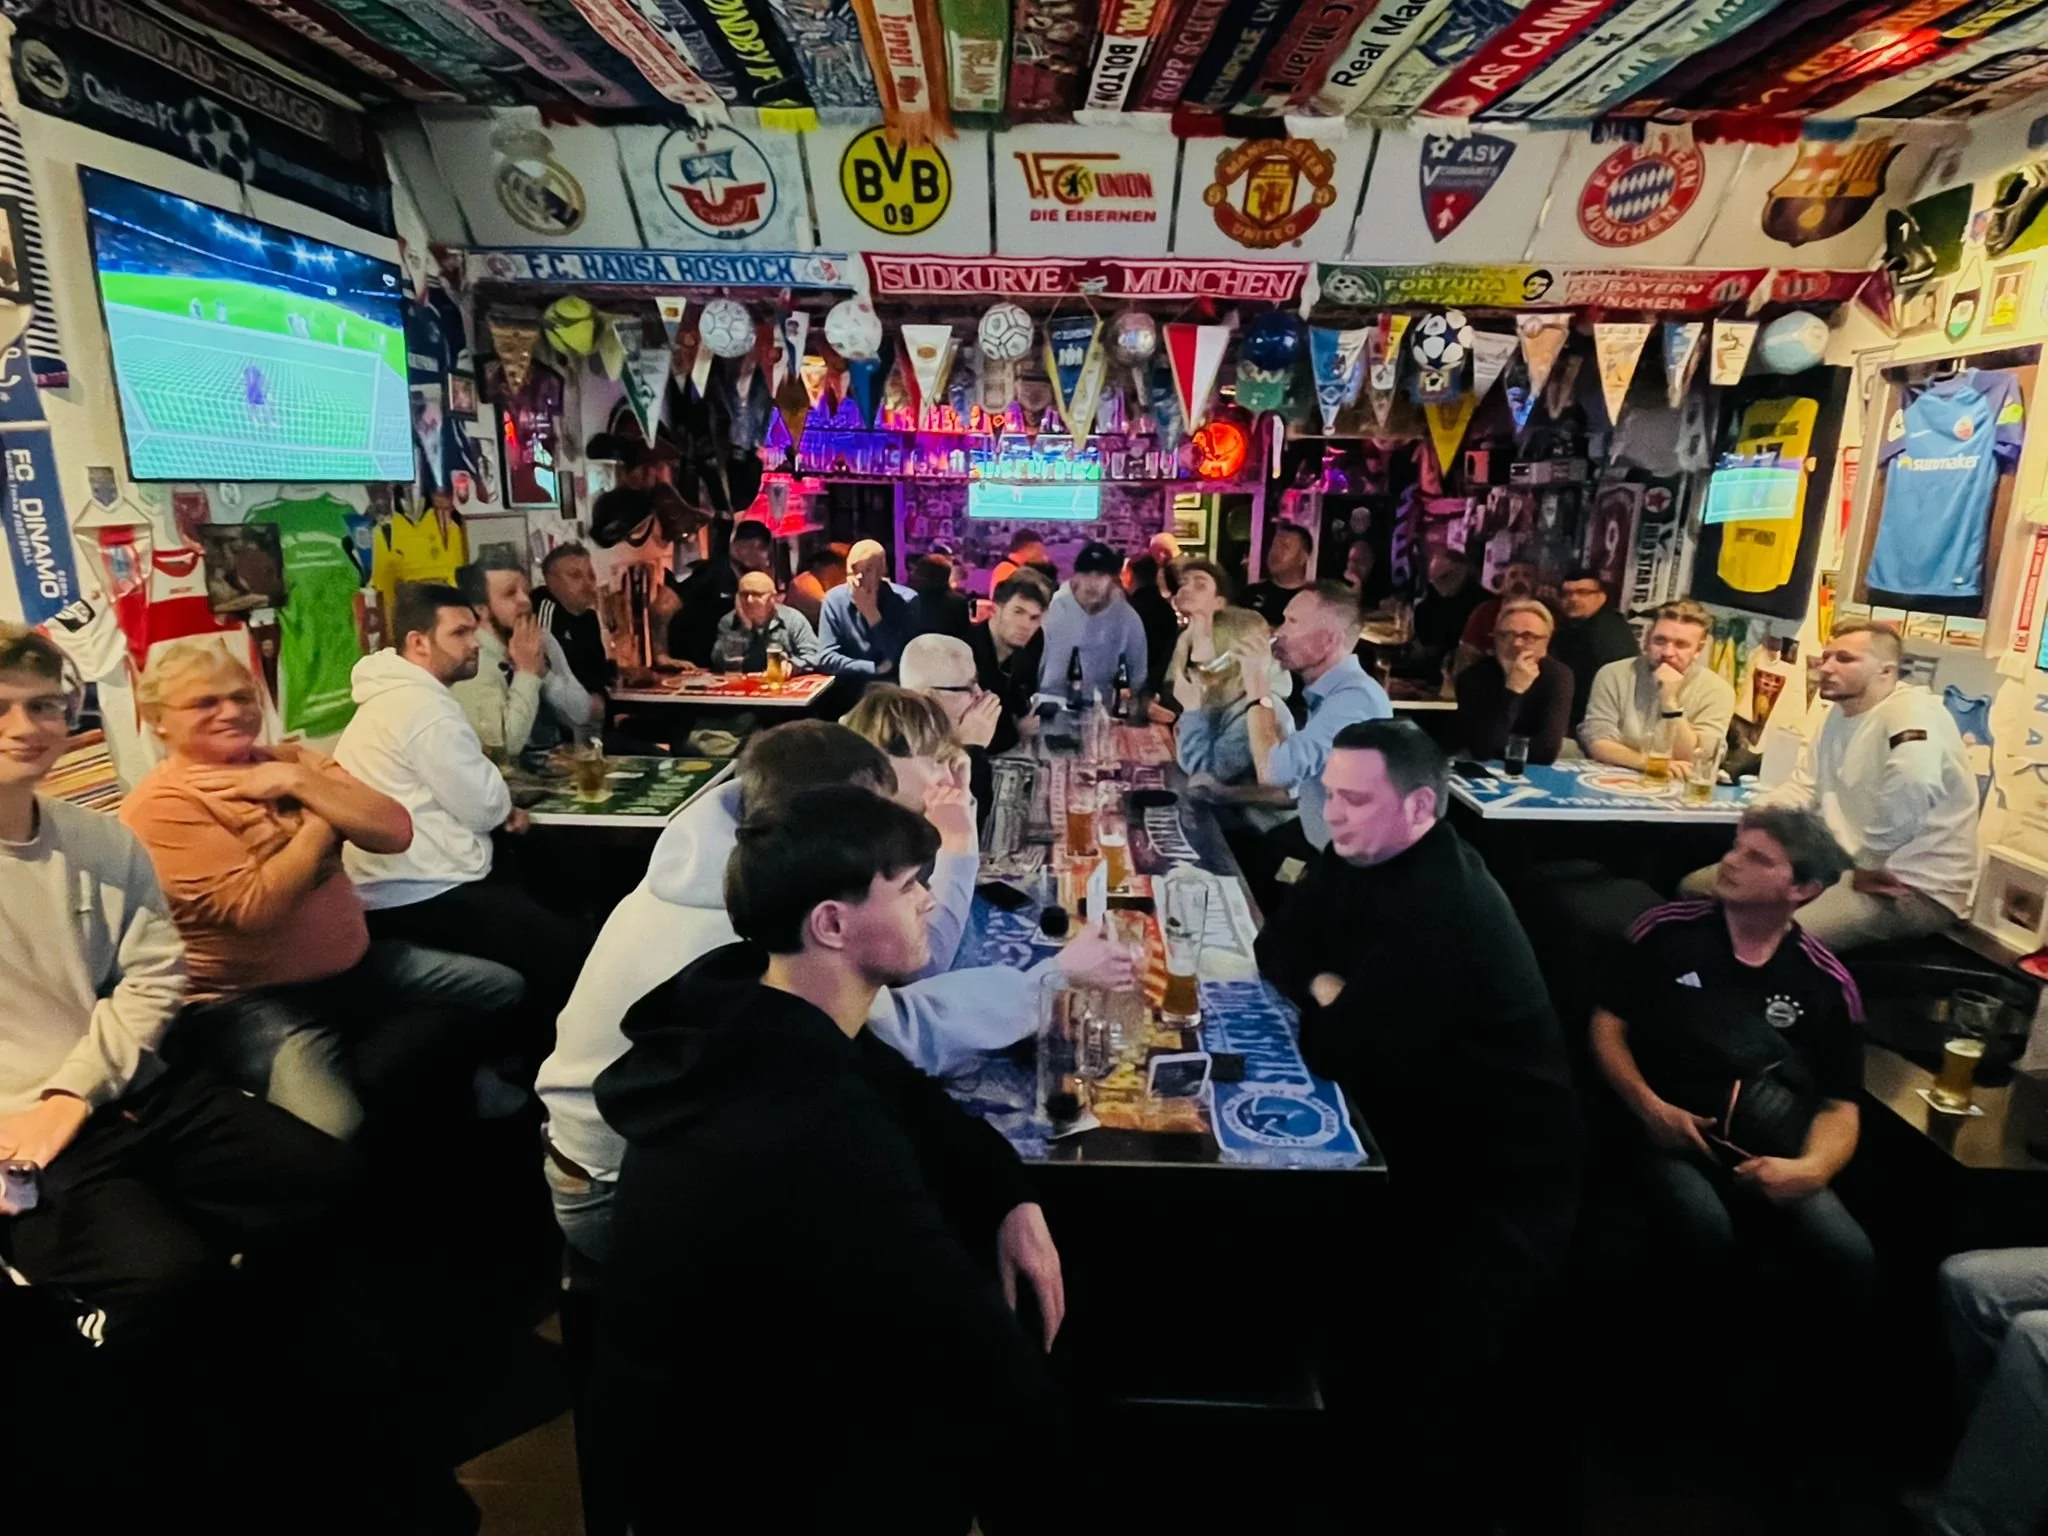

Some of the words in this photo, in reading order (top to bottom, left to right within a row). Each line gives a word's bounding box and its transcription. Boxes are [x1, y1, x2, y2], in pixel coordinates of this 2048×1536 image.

[1096, 43, 1138, 103] BOLTON
[1331, 40, 1391, 89] Real
[1468, 62, 1517, 92] AS
[1456, 144, 1506, 162] ASV
[854, 136, 940, 204] BVB
[1593, 157, 1624, 188] FC
[1095, 173, 1154, 198] UNION
[883, 203, 914, 226] 09
[1029, 209, 1060, 222] DIE
[1065, 209, 1158, 223] EISERNEN
[582, 254, 677, 282] HANSA
[677, 255, 799, 284] ROSTOCK
[1383, 278, 1505, 293] FORTUNA
[1603, 279, 1705, 295] BAYERN
[13, 448, 36, 482] FC
[19, 497, 61, 599] DINAMO
